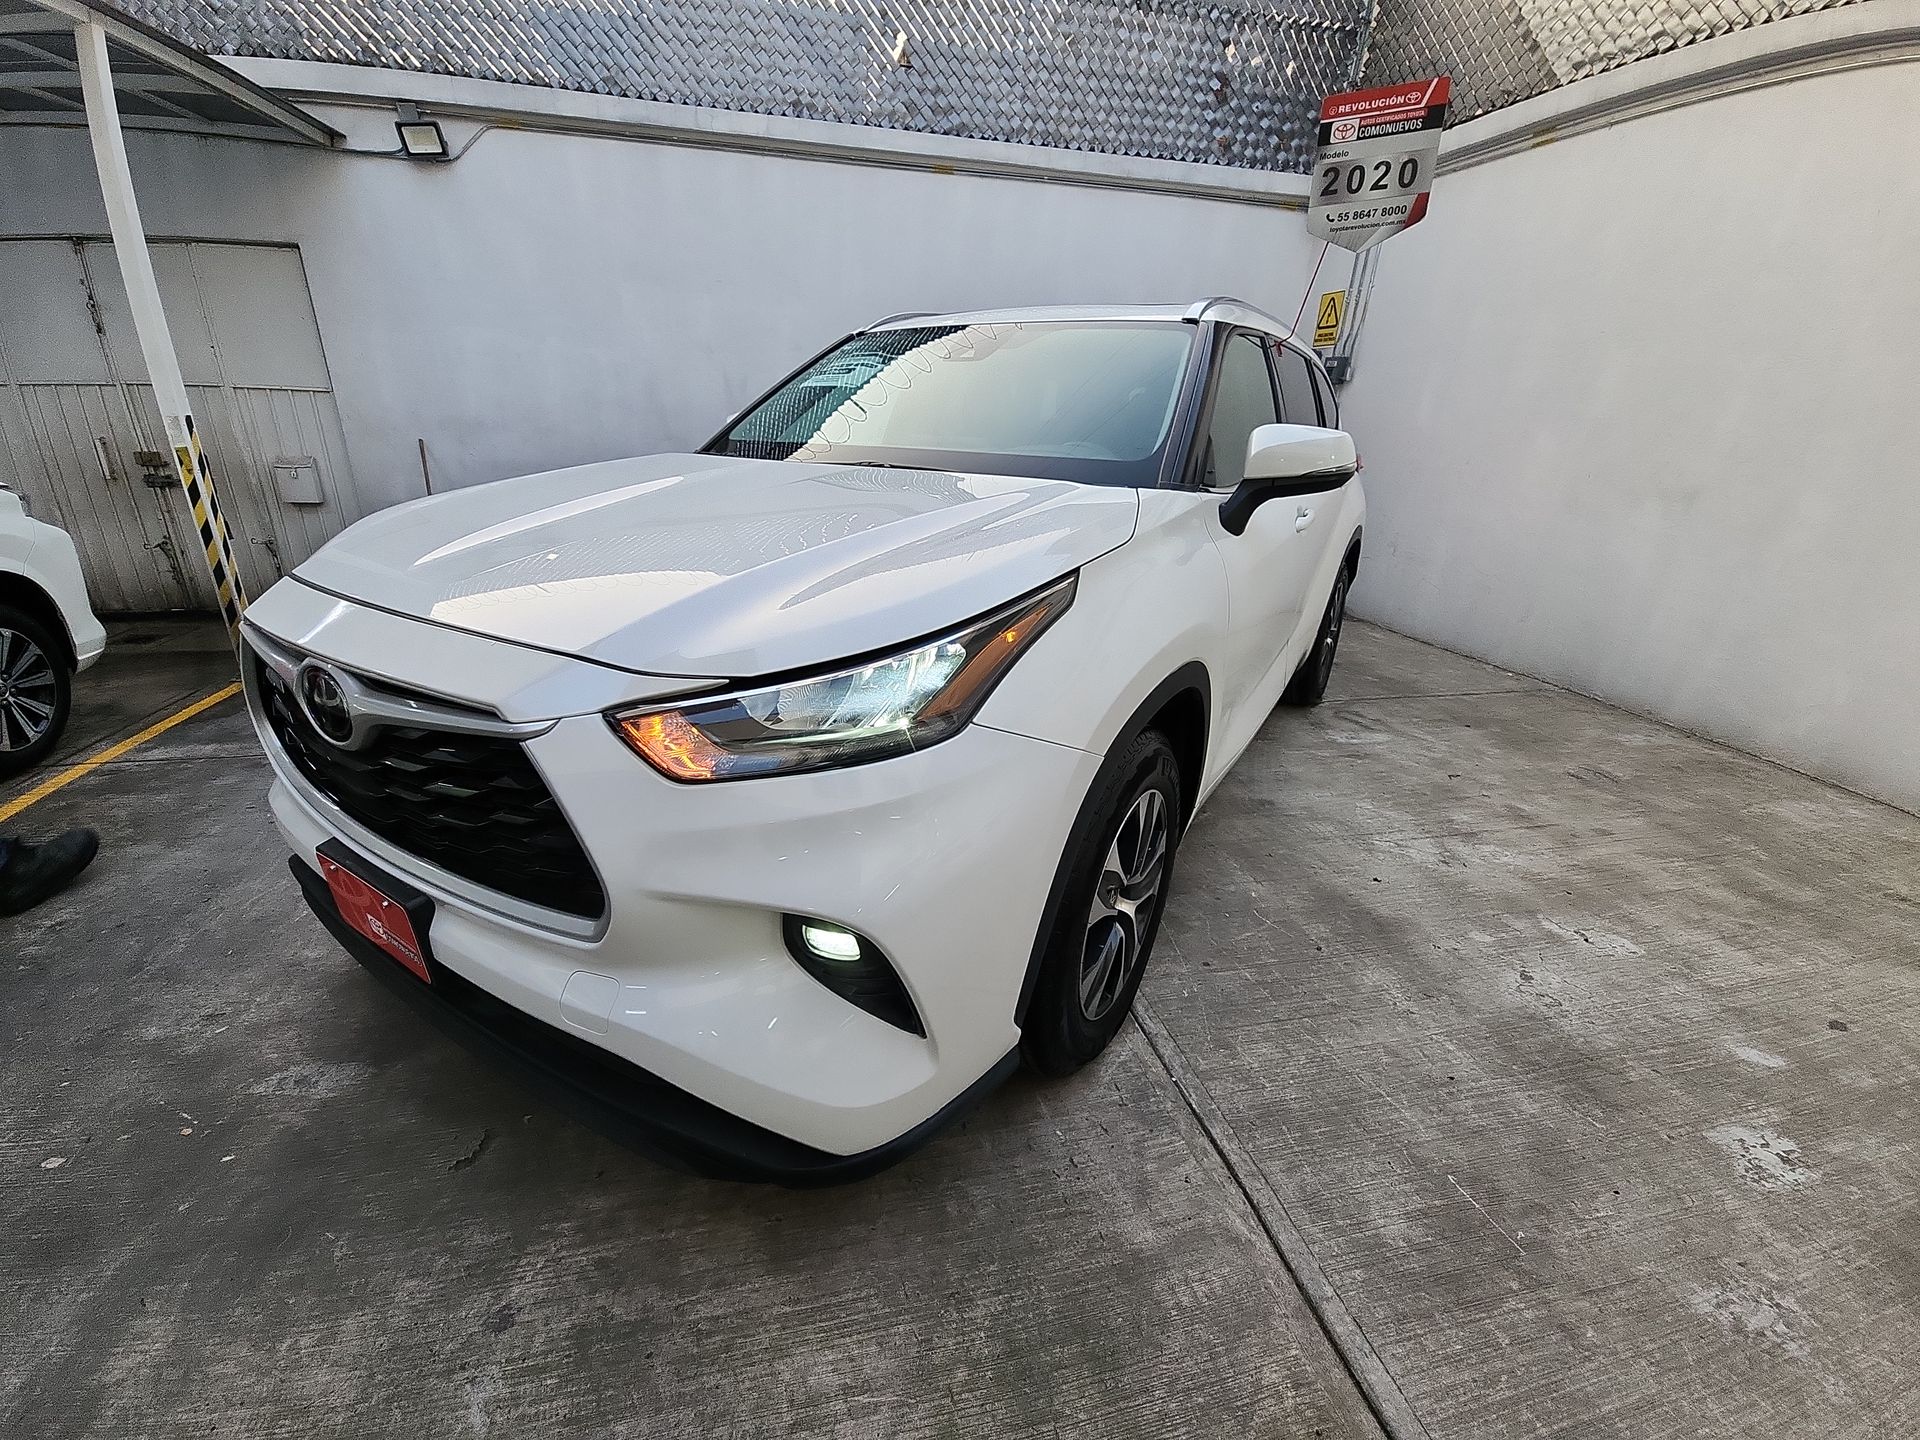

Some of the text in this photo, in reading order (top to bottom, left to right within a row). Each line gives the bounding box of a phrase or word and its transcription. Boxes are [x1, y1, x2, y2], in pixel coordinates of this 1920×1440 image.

[1338, 95, 1404, 114] REVOLUCIÓN
[1359, 118, 1423, 138] COMONUEVOS
[1320, 150, 1349, 161] Modelo
[1320, 158, 1418, 197] 2020
[1337, 204, 1408, 222] 55 8647 8000
